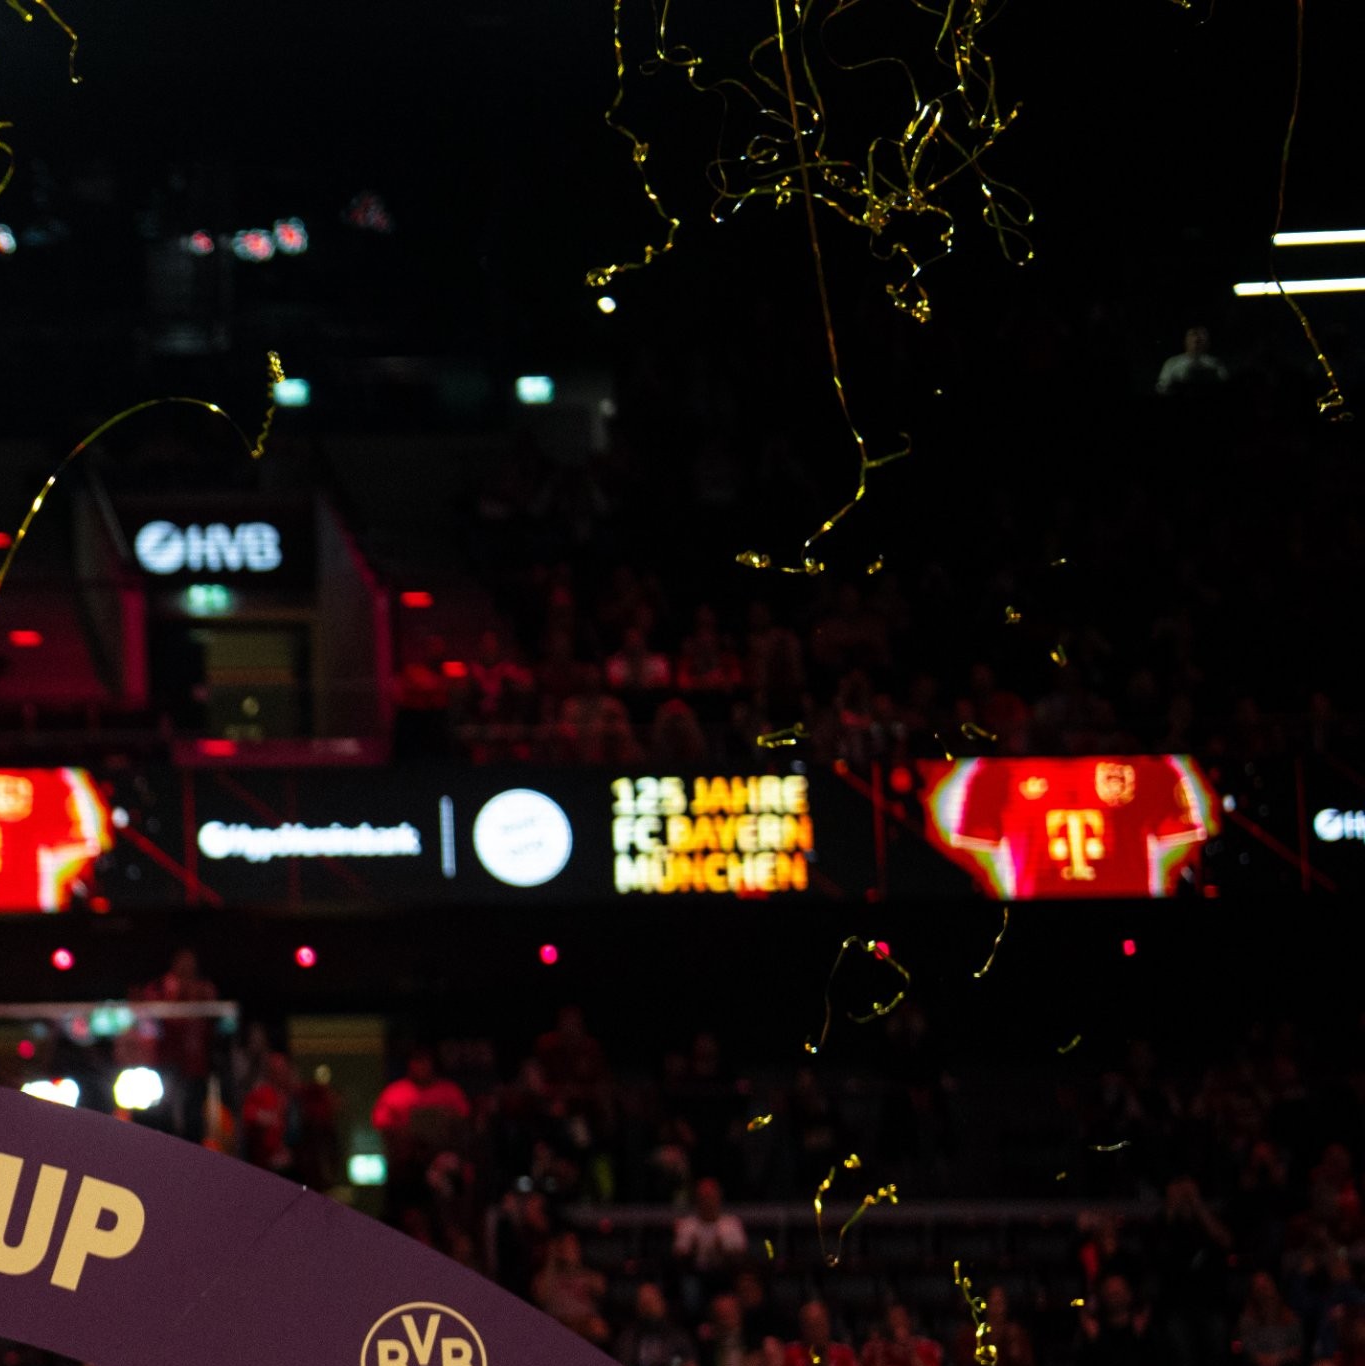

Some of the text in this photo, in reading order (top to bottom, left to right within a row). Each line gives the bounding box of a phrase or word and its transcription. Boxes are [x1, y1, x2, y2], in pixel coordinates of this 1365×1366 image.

[186, 521, 282, 573] HVB
[612, 774, 809, 817] 125 JAHRE
[612, 814, 813, 856] FC BAYERN
[612, 848, 809, 895] MÜNCHEN
